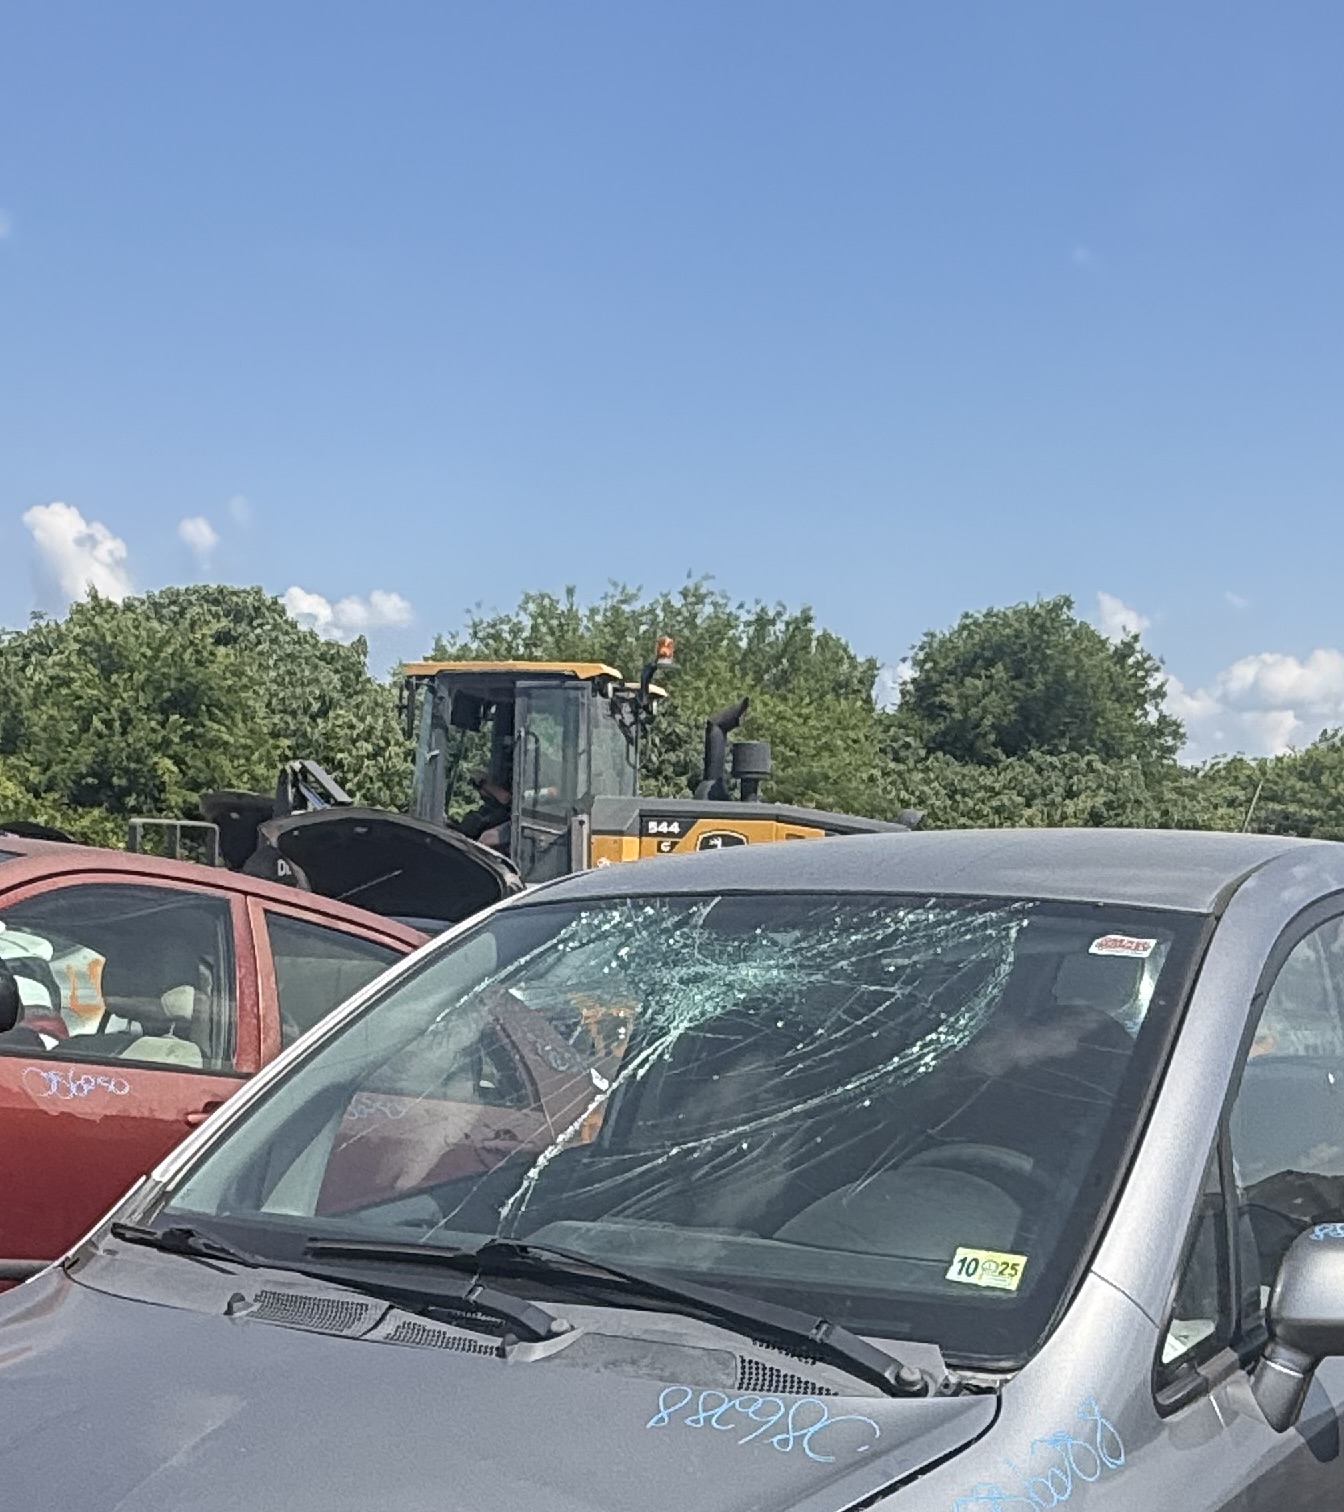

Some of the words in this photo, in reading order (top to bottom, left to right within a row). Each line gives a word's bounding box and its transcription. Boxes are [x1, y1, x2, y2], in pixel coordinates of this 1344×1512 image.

[648, 821, 680, 834] 544
[957, 1256, 980, 1277] 10
[998, 1261, 1020, 1278] 25
